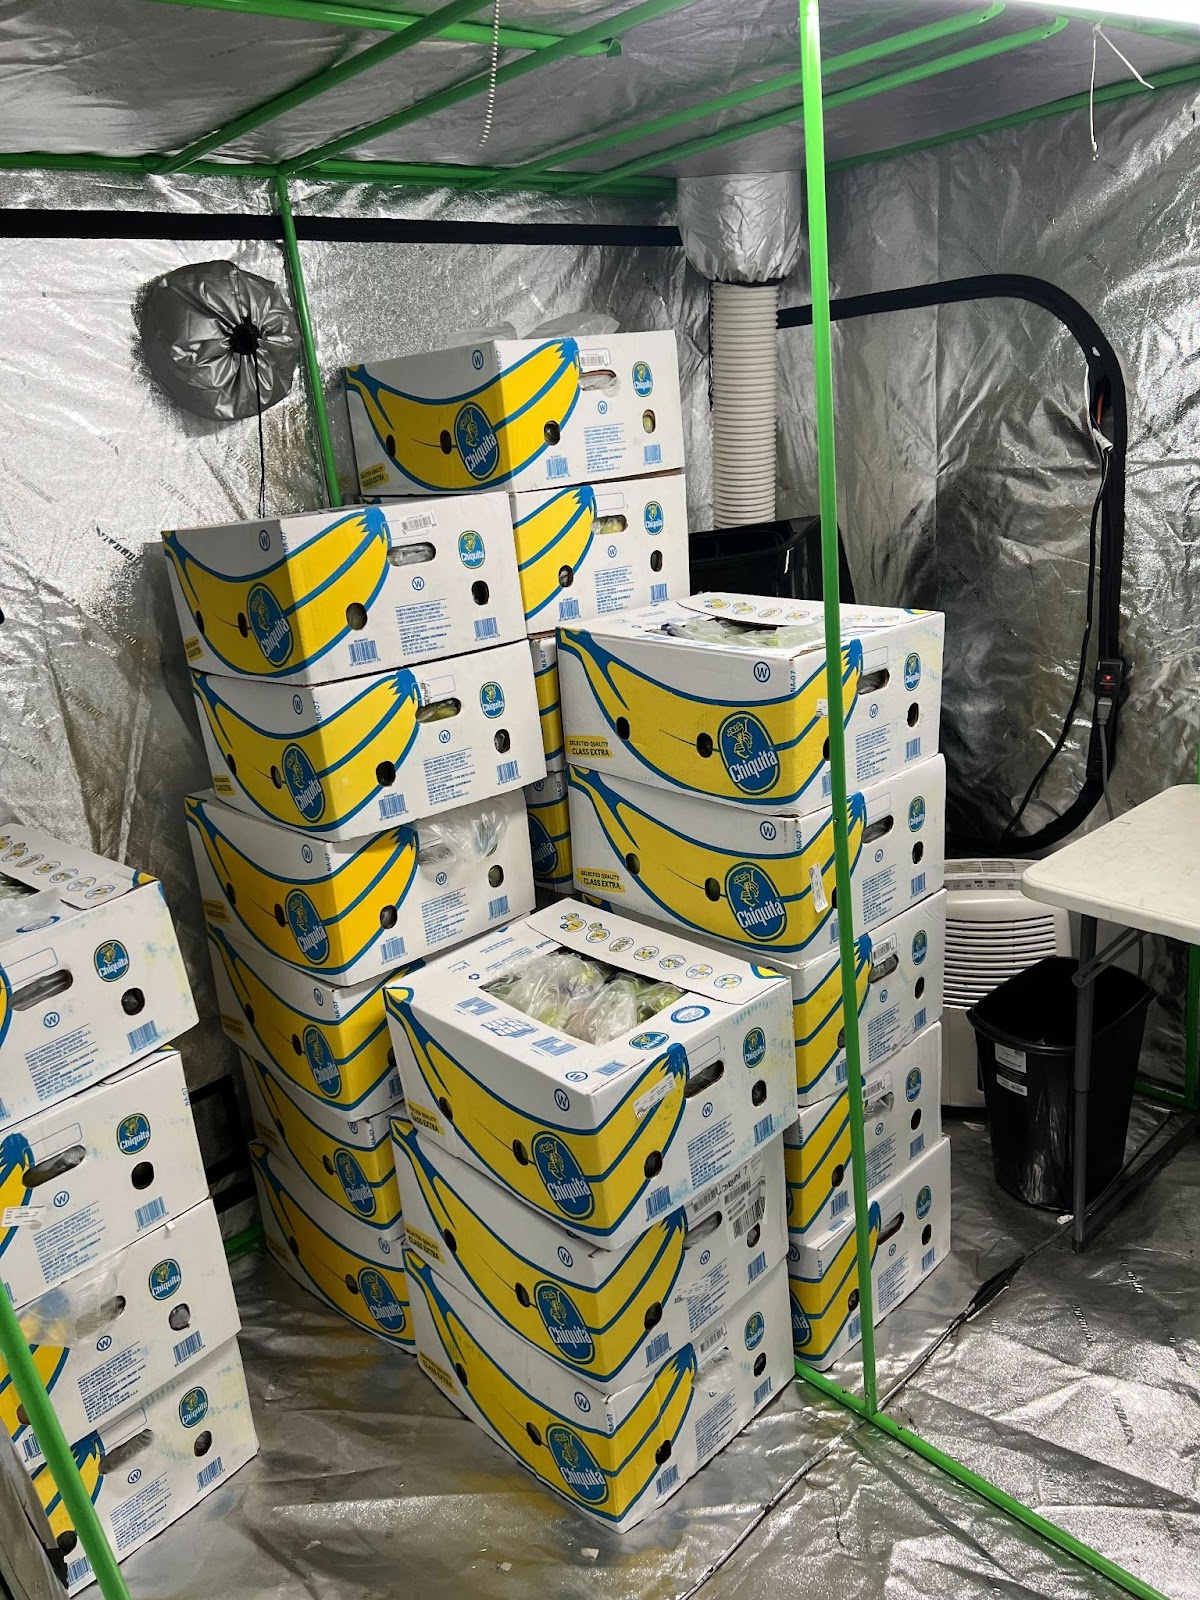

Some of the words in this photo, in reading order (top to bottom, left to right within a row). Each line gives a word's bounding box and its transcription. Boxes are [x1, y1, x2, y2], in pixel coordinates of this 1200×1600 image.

[473, 352, 482, 368] W
[599, 402, 606, 413] W
[464, 433, 496, 472] Chiquita
[260, 532, 269, 549] W
[461, 551, 484, 562] Chiquita
[609, 546, 616, 557] W
[413, 578, 423, 589] W
[261, 616, 289, 658] Chiquita
[755, 663, 769, 680] W
[440, 731, 450, 742] W
[729, 750, 778, 783] Chiquita
[294, 779, 322, 811] Chiquita
[761, 823, 775, 839] W
[303, 846, 312, 862] W
[437, 873, 446, 884] W
[583, 878, 601, 887] CLASS
[601, 880, 620, 890] EXTRA
[736, 902, 784, 929] Chiquita
[298, 925, 327, 952] Chiquita
[99, 959, 128, 977] Chiquita
[45, 1013, 58, 1026] W
[313, 1064, 339, 1085] Chiquita
[556, 1090, 568, 1109] W
[703, 1104, 712, 1116] W
[120, 1131, 150, 1150] Chiquita
[55, 1192, 68, 1206] W
[346, 1185, 373, 1204] Chiquita
[547, 1179, 590, 1203] Chiquita
[380, 1239, 389, 1252] W
[559, 1248, 571, 1265] W
[701, 1251, 709, 1263] W
[152, 1275, 181, 1296] Chiquita
[370, 1304, 402, 1322] Chiquita
[98, 1337, 110, 1349] W
[549, 1326, 591, 1348] Chiquita
[576, 1394, 589, 1410] W
[182, 1403, 207, 1424] Chiquita
[129, 1470, 140, 1482] W
[561, 1466, 605, 1489] Chiquita
